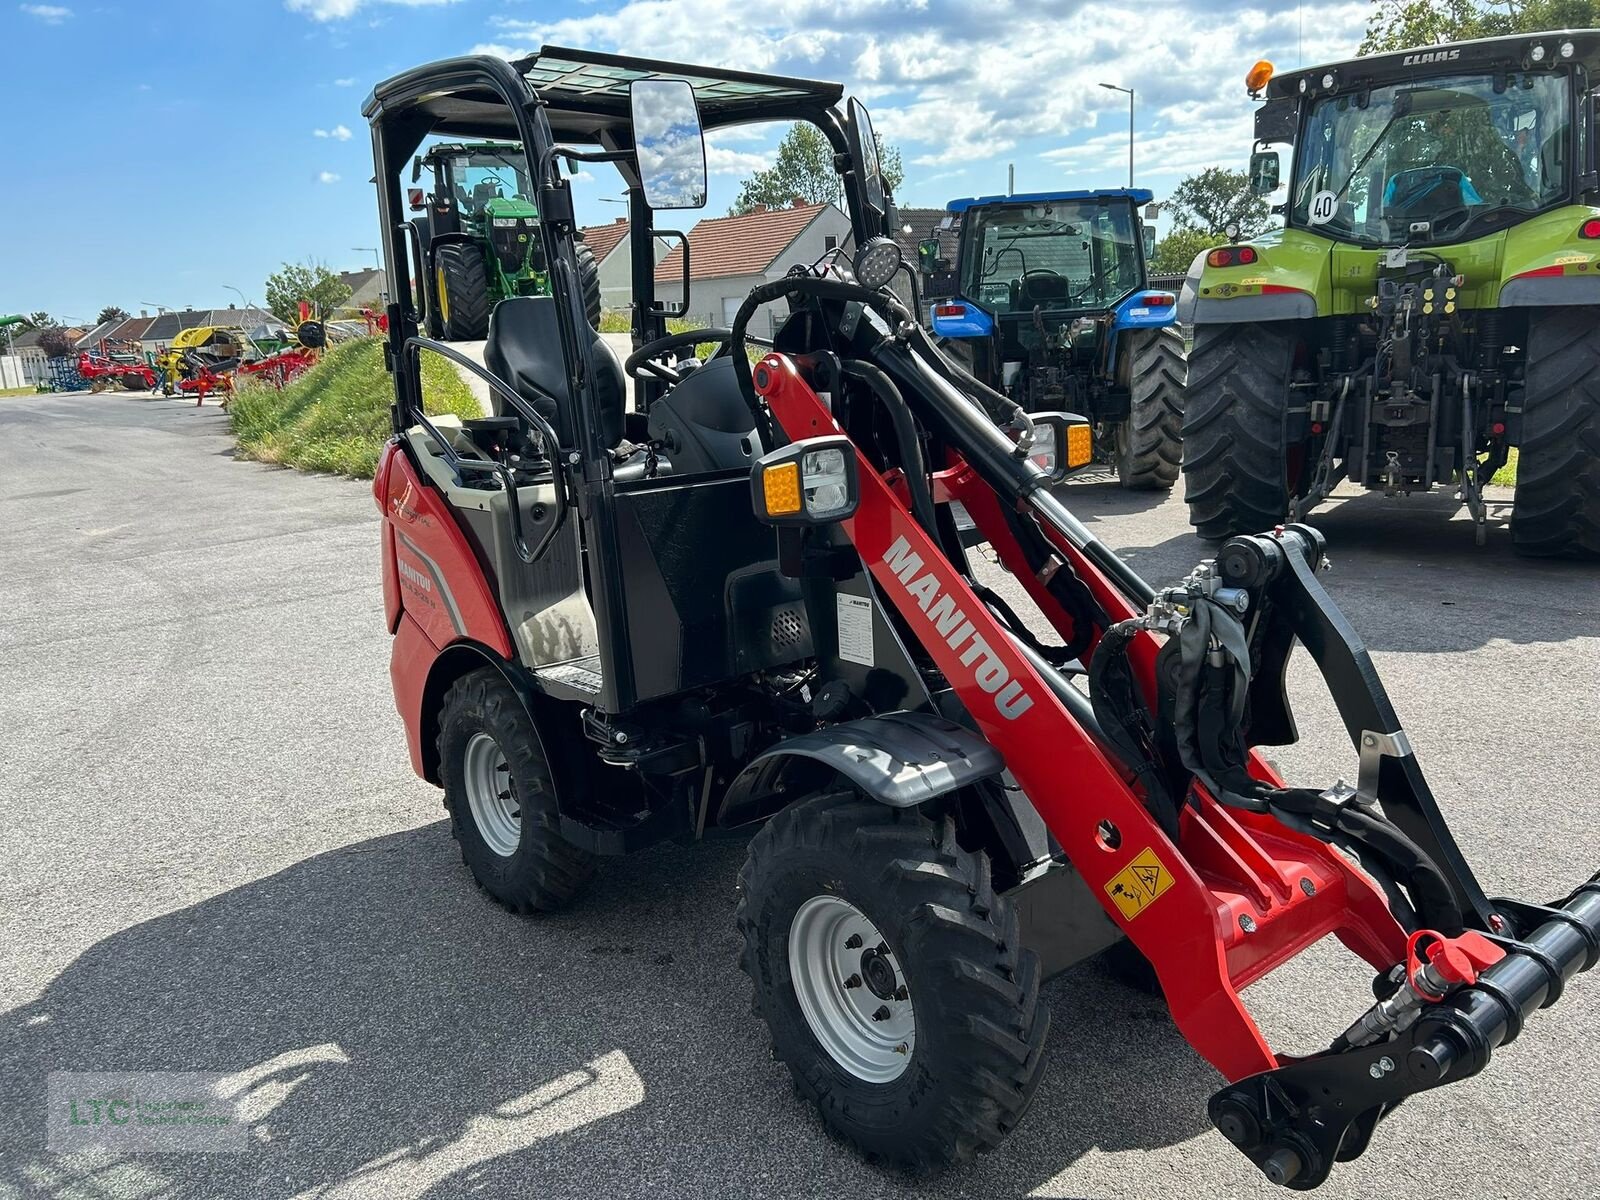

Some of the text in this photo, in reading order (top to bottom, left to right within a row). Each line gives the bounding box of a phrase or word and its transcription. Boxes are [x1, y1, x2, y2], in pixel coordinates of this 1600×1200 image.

[1403, 49, 1460, 66] CLAAS
[1314, 196, 1332, 218] 40
[882, 535, 1035, 720] MANITOU
